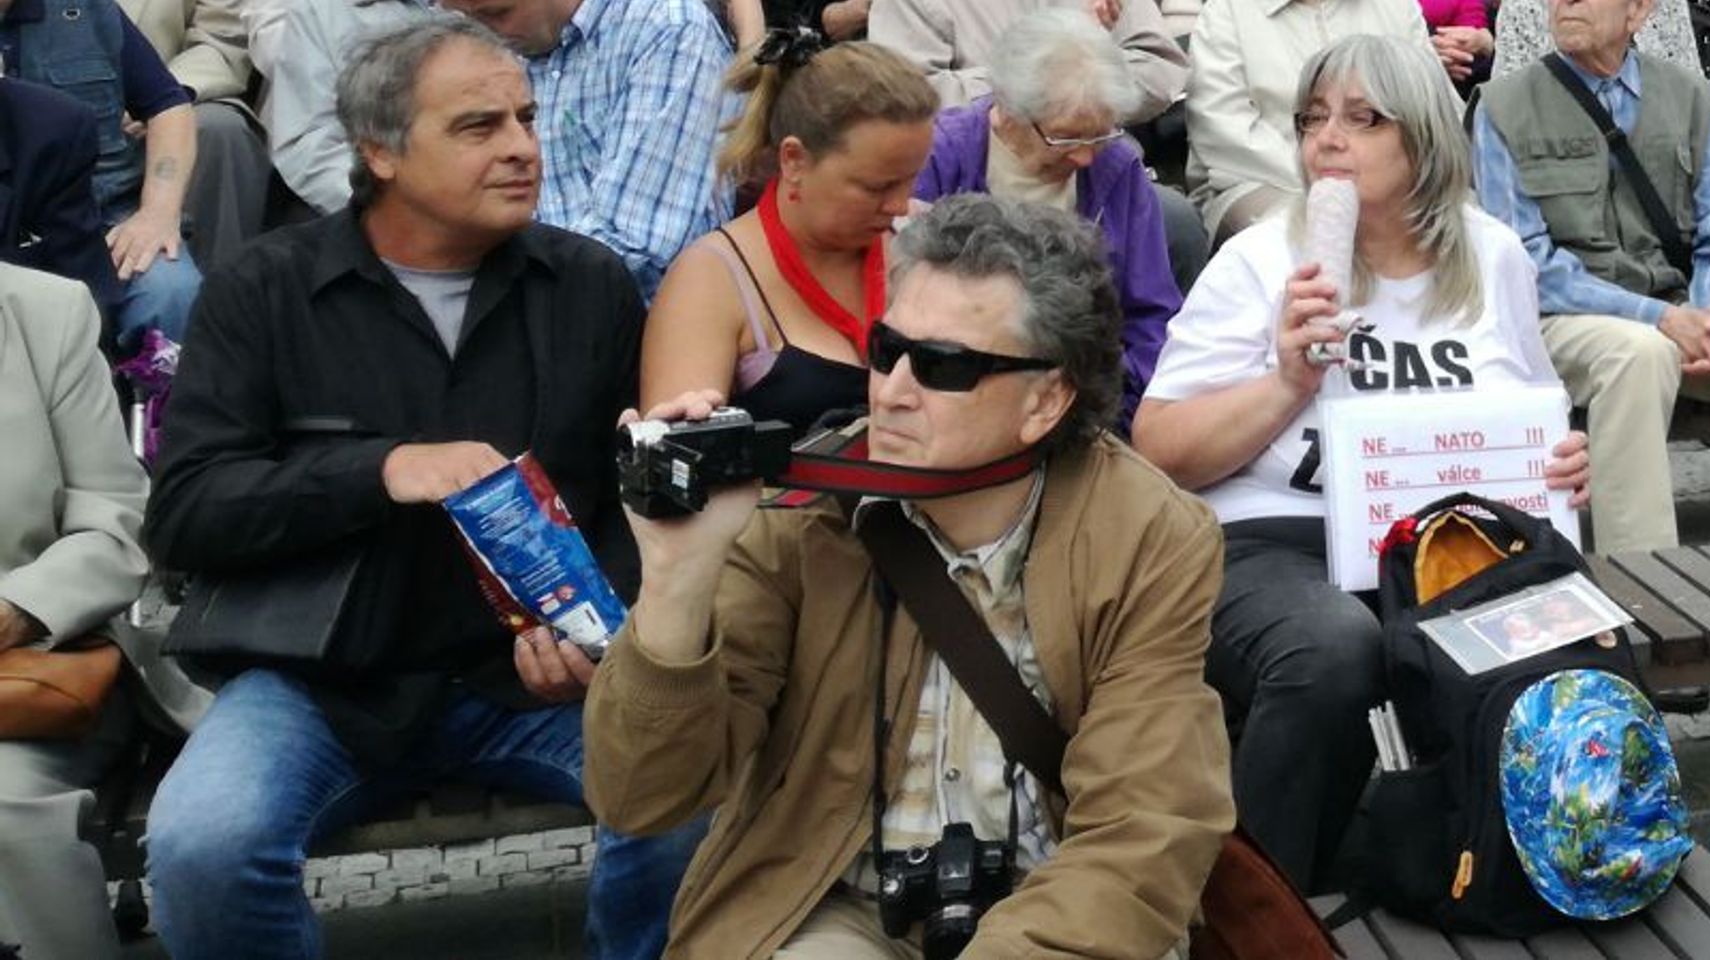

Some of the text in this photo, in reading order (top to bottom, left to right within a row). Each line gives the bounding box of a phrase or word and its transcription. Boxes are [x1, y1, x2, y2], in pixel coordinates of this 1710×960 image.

[1350, 324, 1474, 391] ČAS
[1362, 438, 1387, 454] NE
[1434, 431, 1484, 449] NATO
[1365, 471, 1391, 487] NE
[1437, 464, 1481, 482] válce
[1368, 503, 1393, 520] NE
